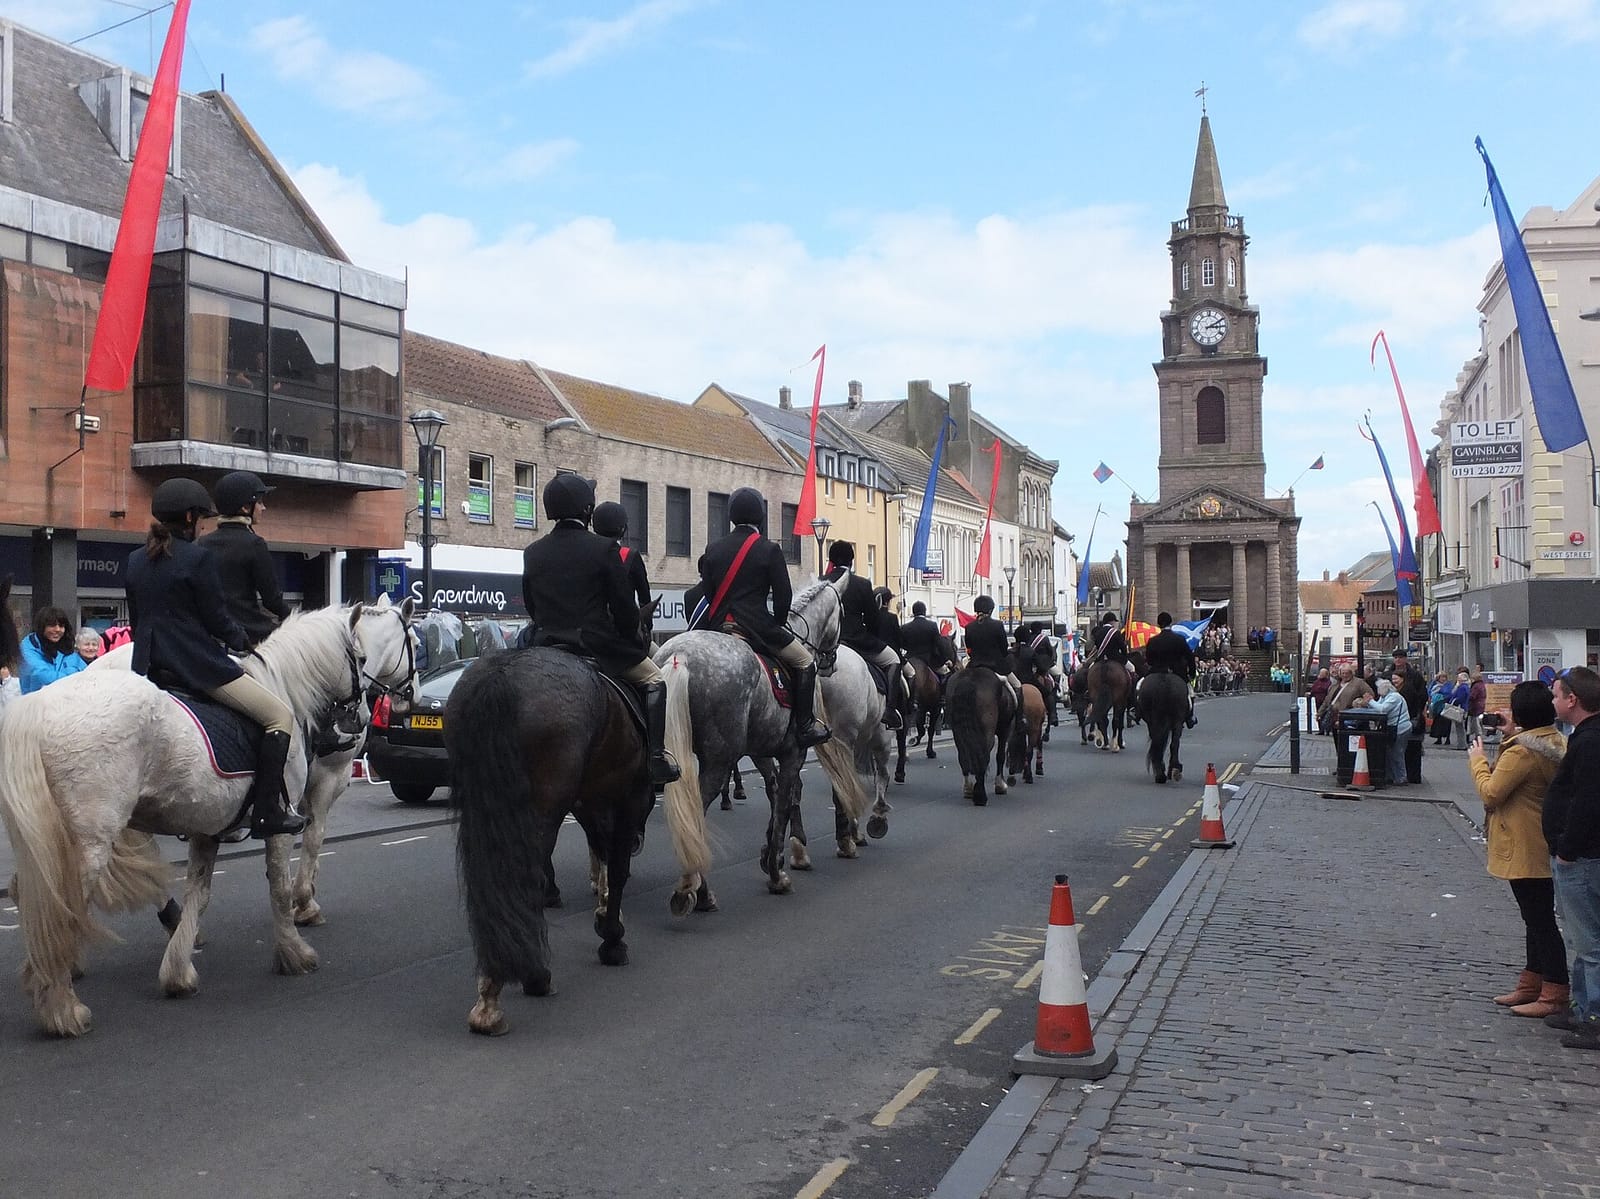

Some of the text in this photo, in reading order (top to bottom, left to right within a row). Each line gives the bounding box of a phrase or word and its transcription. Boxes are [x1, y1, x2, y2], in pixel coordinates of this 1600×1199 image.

[1457, 421, 1516, 437] TO LET
[1454, 444, 1519, 457] GAVINBLACK
[1452, 464, 1521, 476] 0191 230 2777
[78, 559, 120, 575] rmacy
[411, 580, 507, 611] Sperdrug
